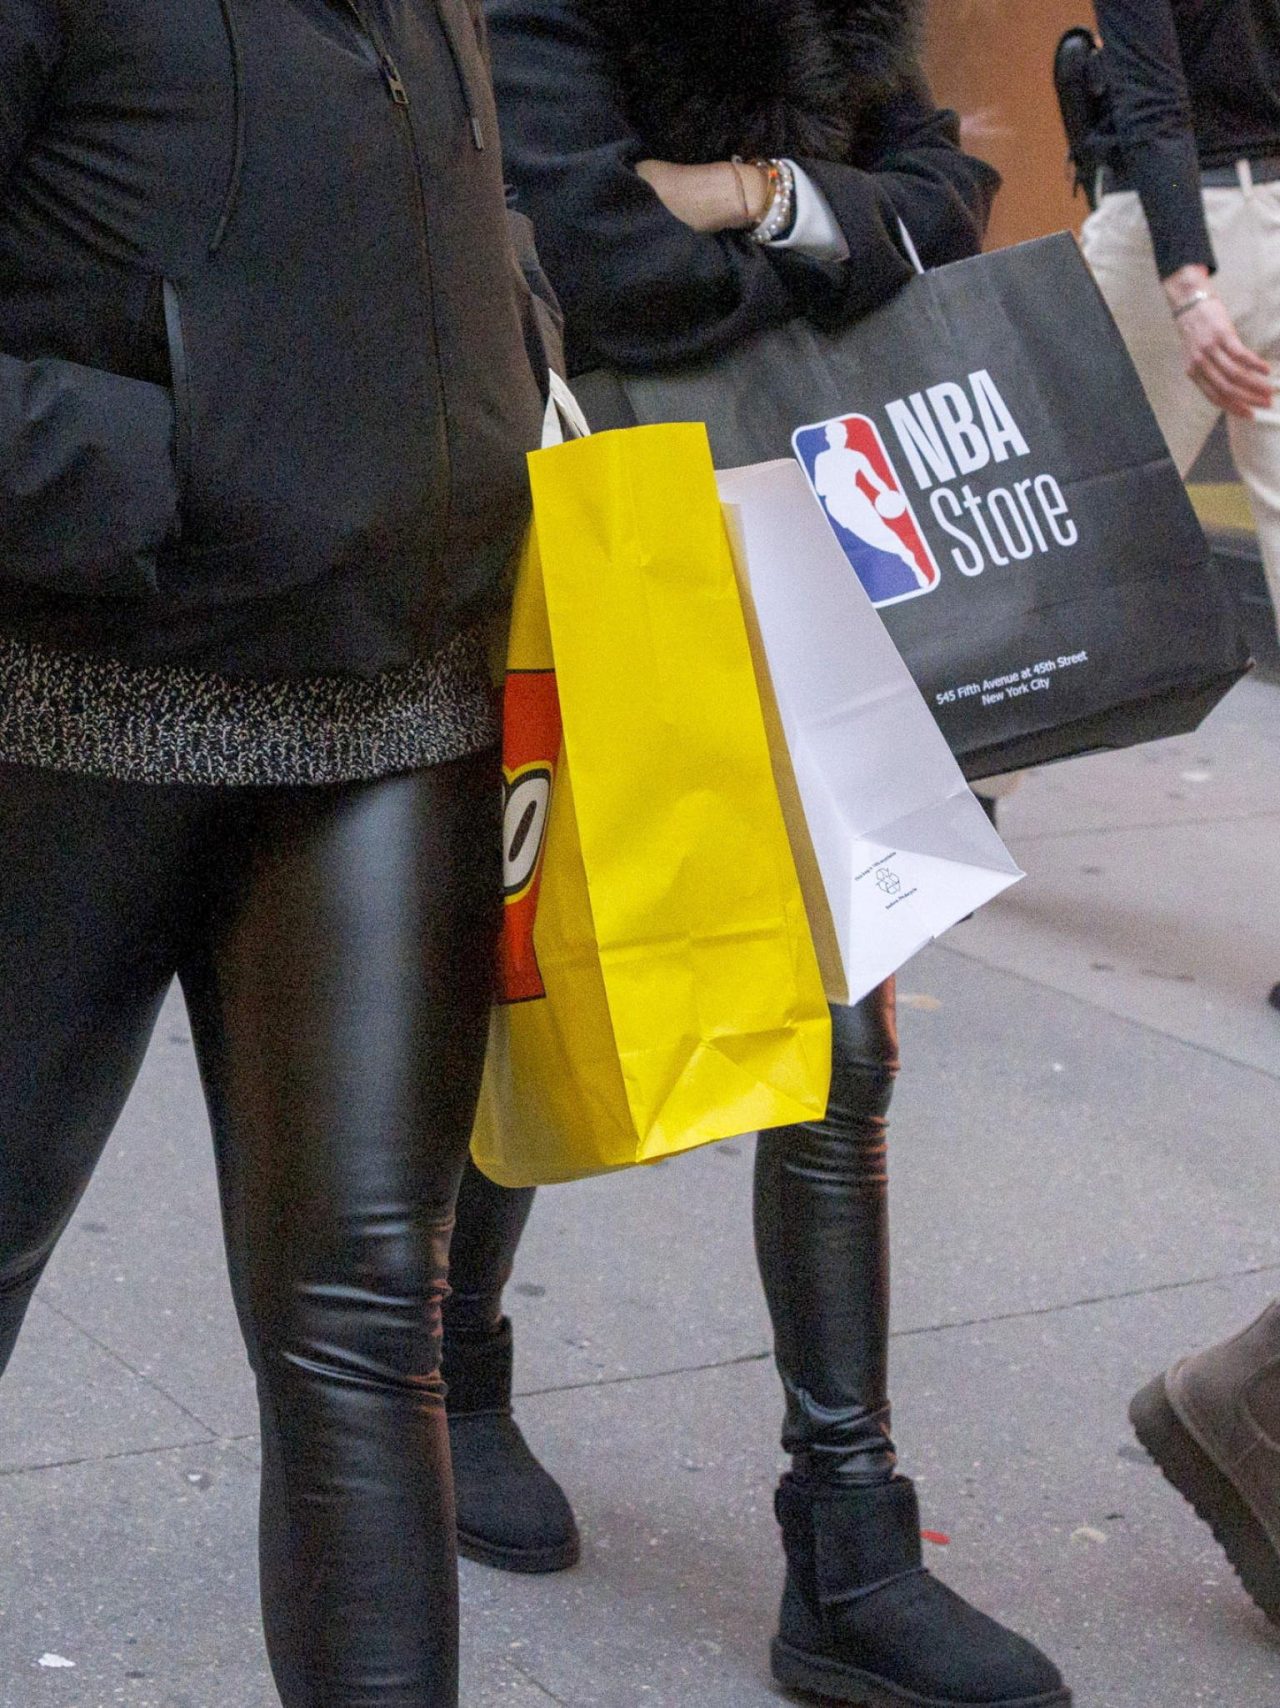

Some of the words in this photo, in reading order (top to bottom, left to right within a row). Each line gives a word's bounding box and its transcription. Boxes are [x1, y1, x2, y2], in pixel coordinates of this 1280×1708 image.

[884, 369, 1030, 490] NBA
[929, 474, 1078, 577] Store
[936, 690, 956, 705] 545
[957, 683, 981, 699] Fifth
[982, 672, 1020, 692] Avenue
[1021, 667, 1033, 680] at
[1033, 660, 1057, 675] 45th
[1057, 650, 1088, 668] Street
[981, 691, 1005, 706] New
[1006, 683, 1030, 698] York
[1030, 677, 1051, 691] City
